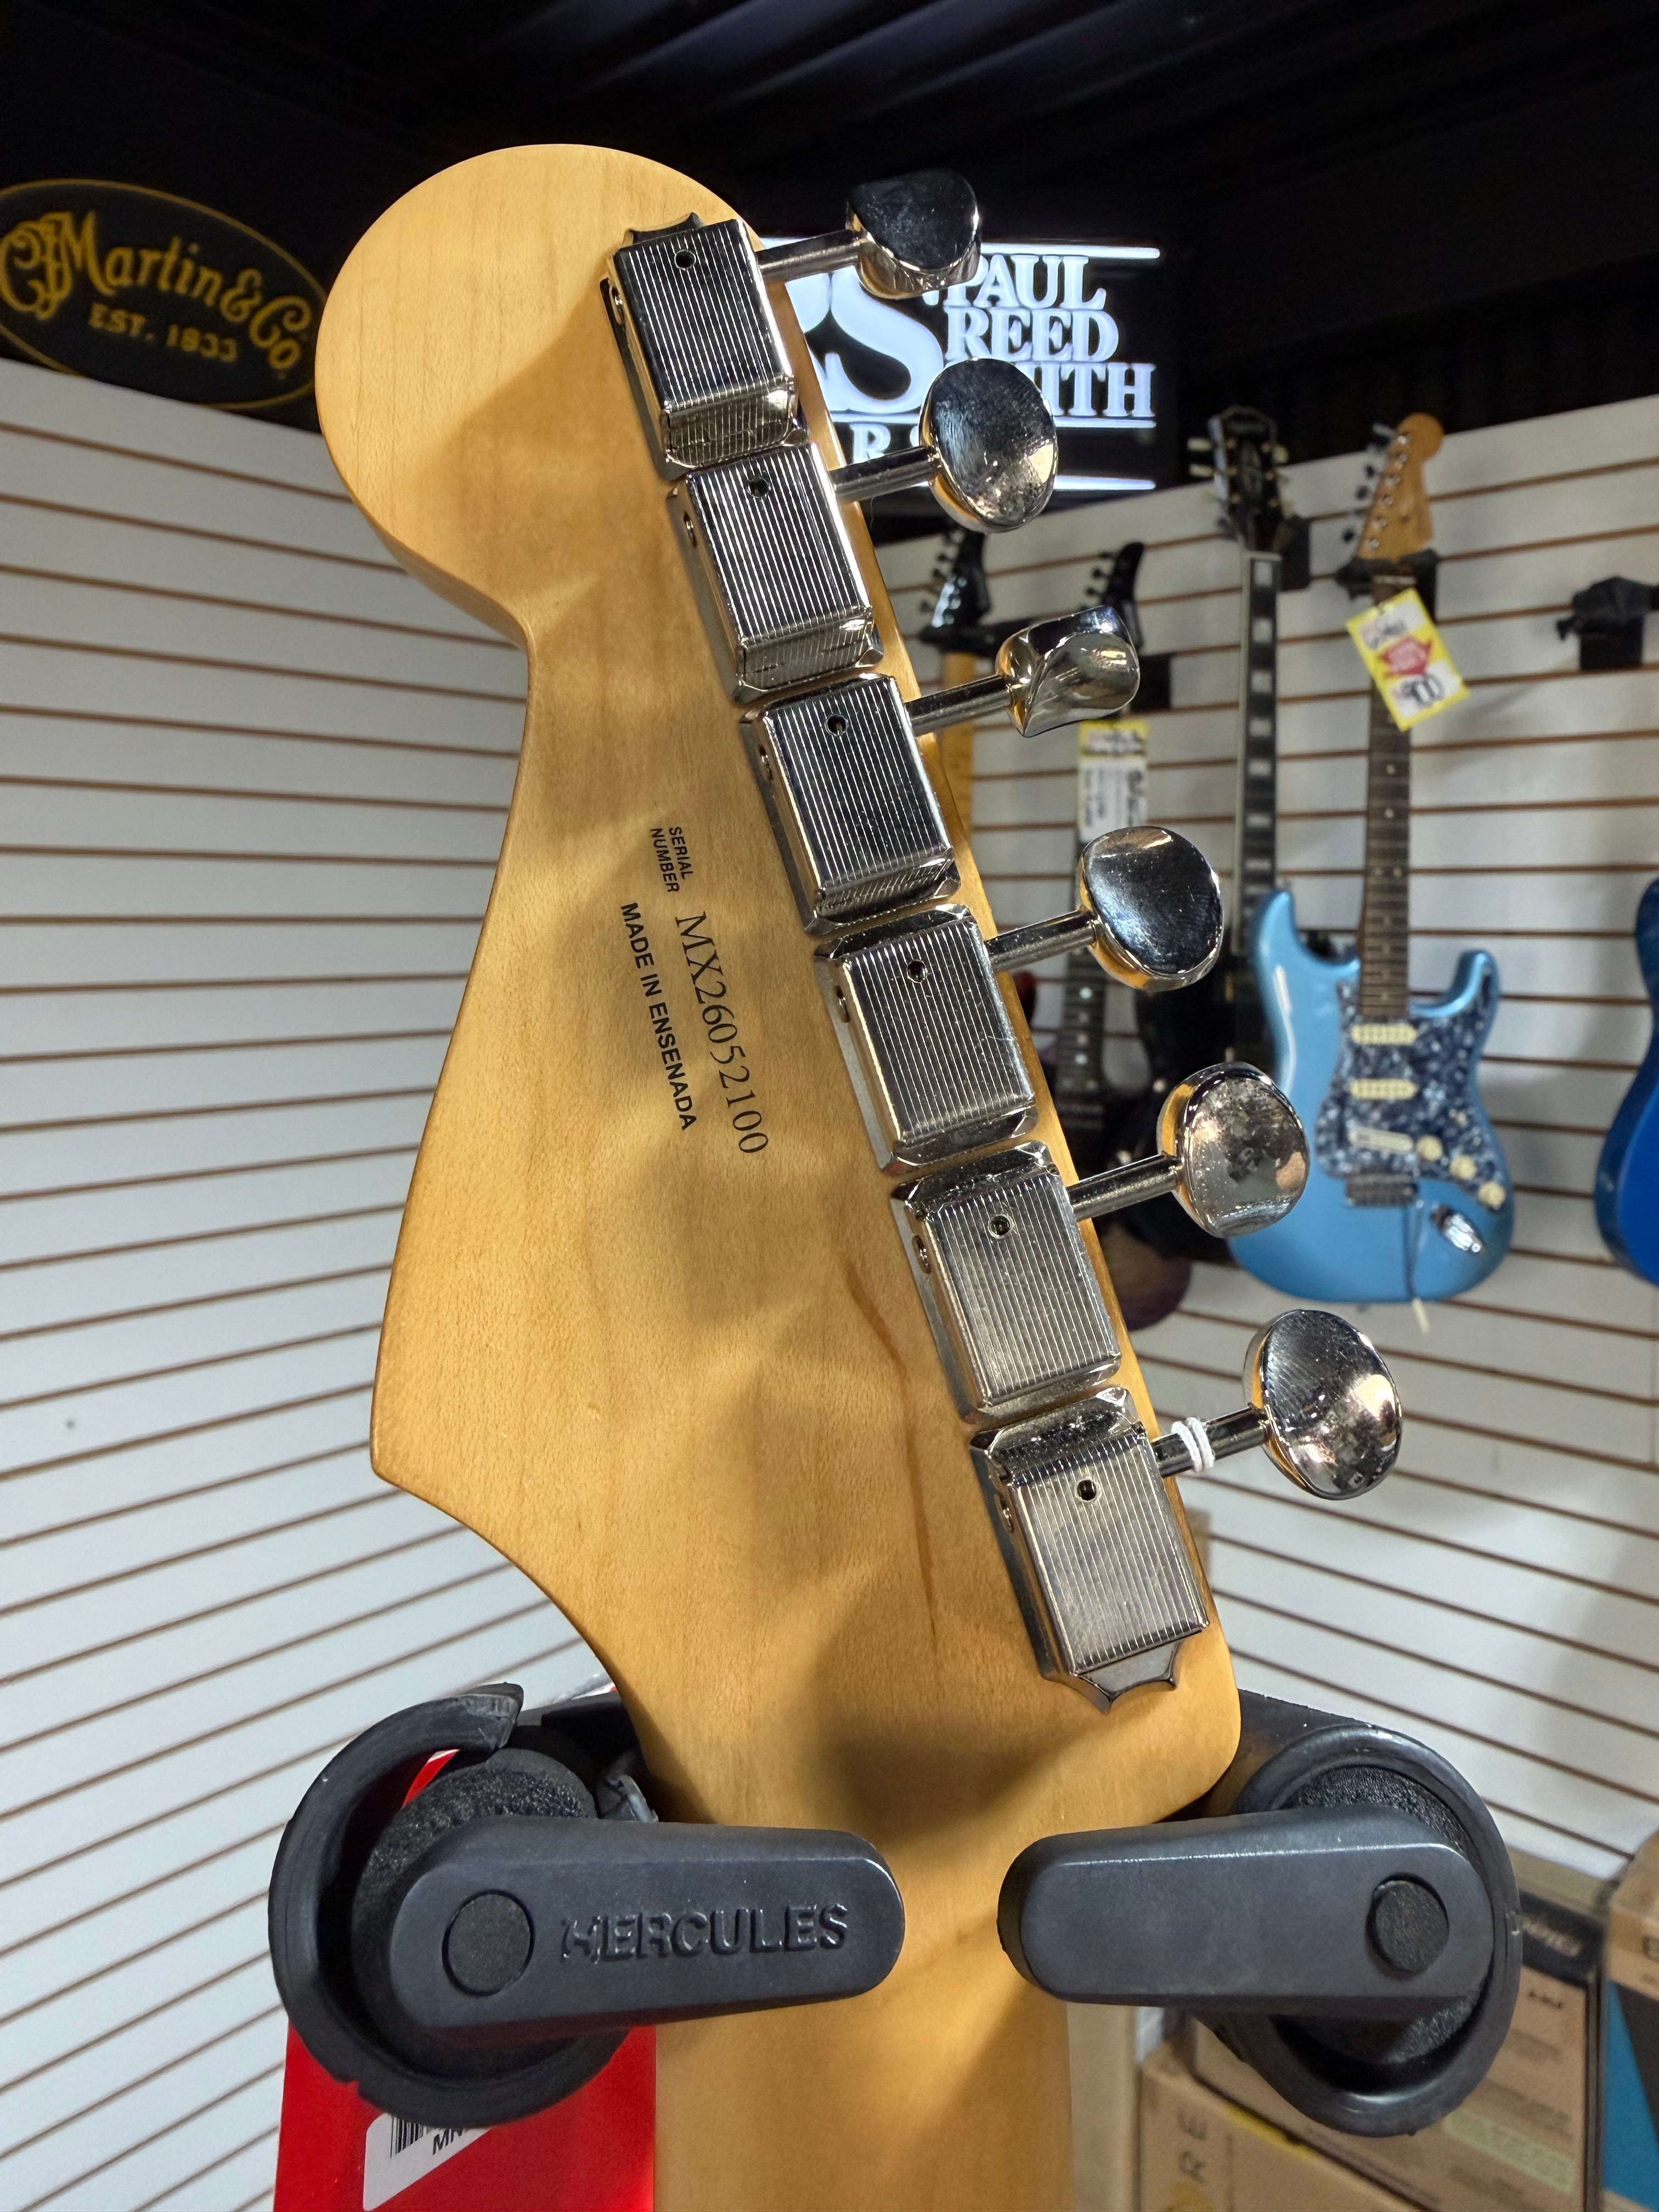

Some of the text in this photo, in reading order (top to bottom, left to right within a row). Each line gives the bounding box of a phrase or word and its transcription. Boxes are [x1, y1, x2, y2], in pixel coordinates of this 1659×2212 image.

[943, 307, 1119, 362] REED
[650, 827, 680, 893] NUMBER
[668, 826, 694, 880] SERIAL
[620, 902, 697, 1131] MADE IN ENSENADA
[675, 911, 769, 1154] MX26052100
[560, 1904, 848, 1965] HERCULES
